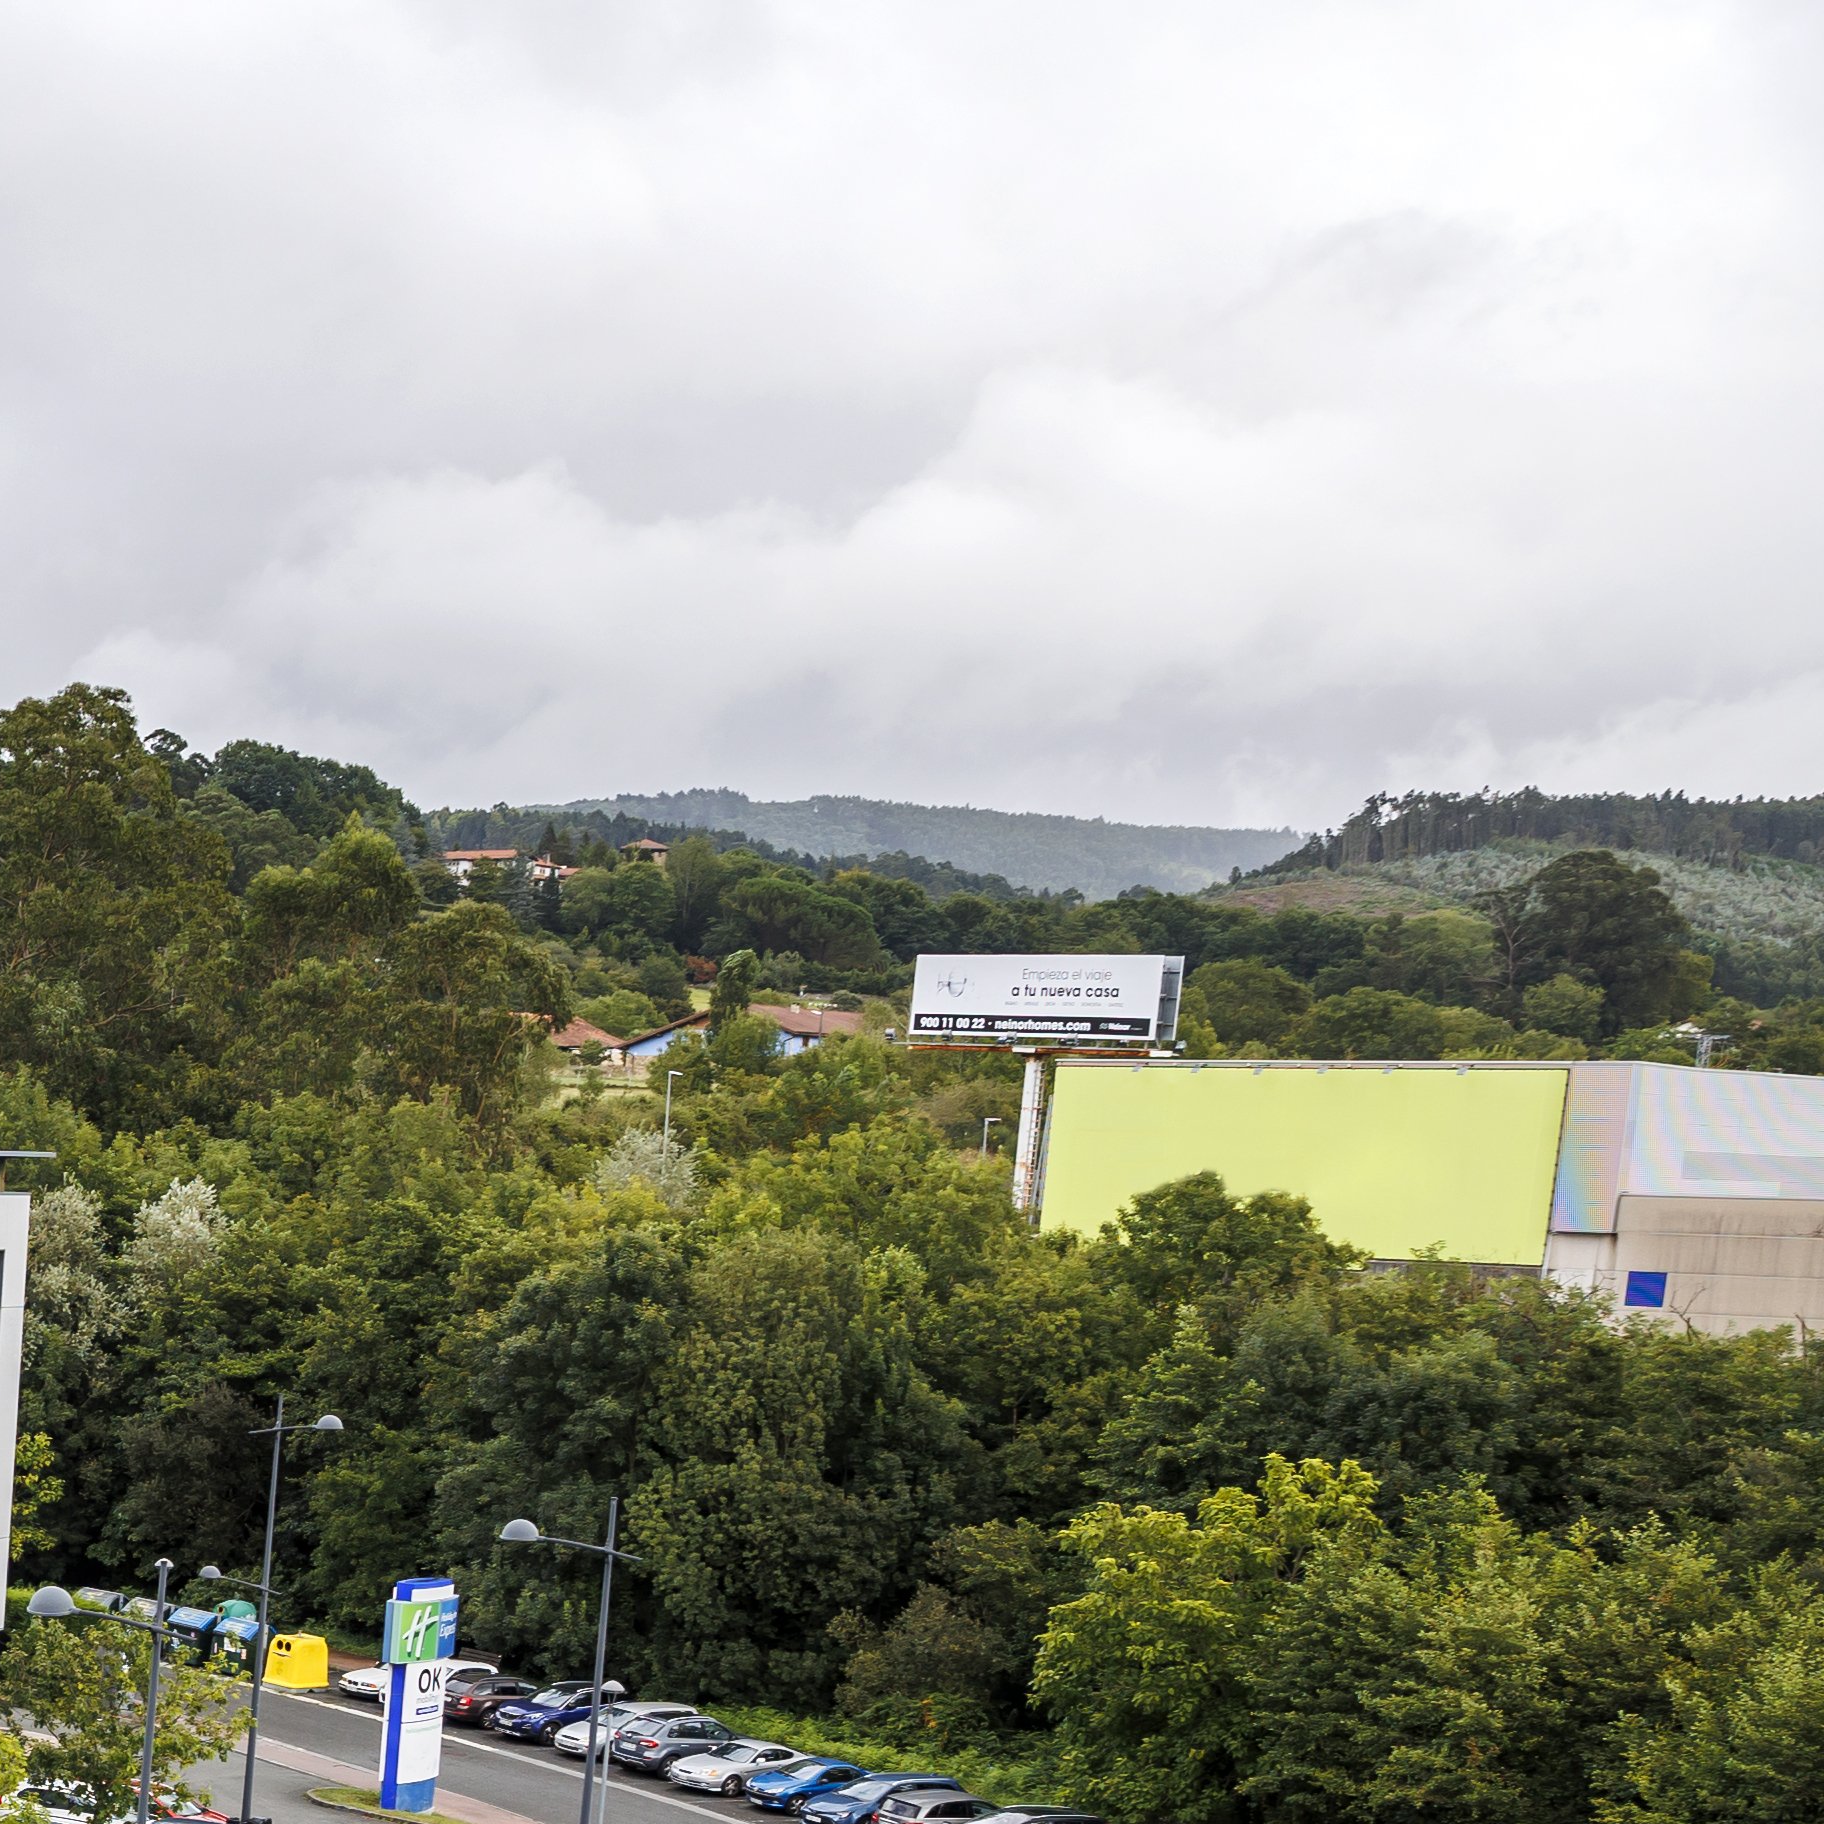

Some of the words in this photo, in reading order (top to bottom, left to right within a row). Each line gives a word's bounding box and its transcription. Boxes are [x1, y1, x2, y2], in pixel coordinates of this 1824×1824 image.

[1022, 968, 1069, 982] Empieza
[1072, 968, 1083, 980] el
[1085, 969, 1112, 982] viaje
[1011, 986, 1020, 997] a
[1024, 984, 1036, 997] tu
[1040, 986, 1081, 998] nueva
[1085, 987, 1120, 998] casa
[920, 1016, 940, 1028] 900
[942, 1017, 953, 1028] 11
[956, 1017, 970, 1029] 00
[971, 1018, 985, 1029] 22
[994, 1018, 1091, 1031] neinorhomes.com
[418, 1666, 442, 1693] OK
